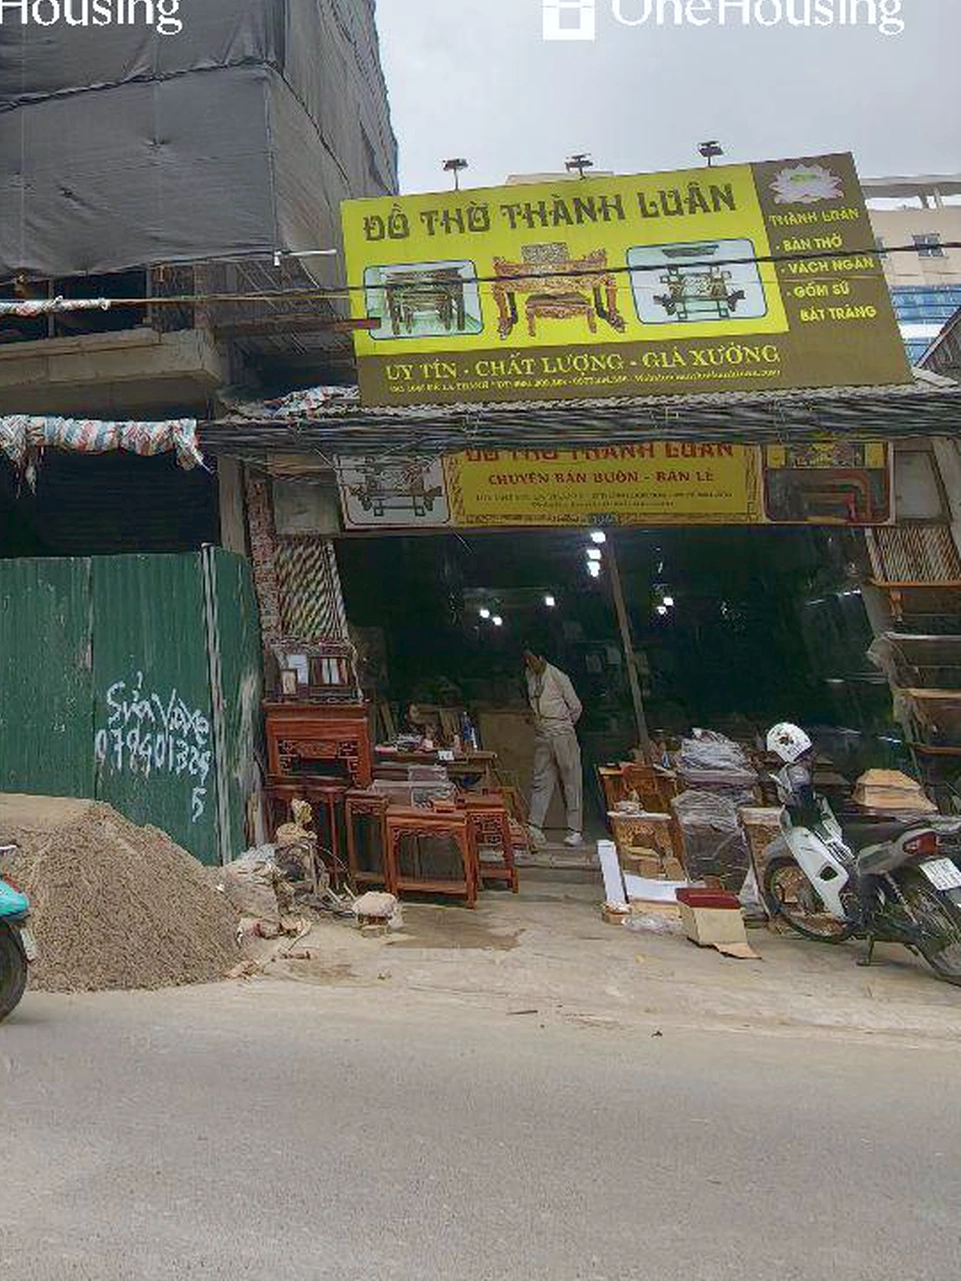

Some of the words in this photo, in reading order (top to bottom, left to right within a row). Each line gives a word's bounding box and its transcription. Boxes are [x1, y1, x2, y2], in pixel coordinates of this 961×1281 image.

[363, 203, 410, 241] ĐỒ
[420, 201, 491, 236] THỜ
[500, 194, 626, 229] THÀNH
[636, 182, 737, 218] LUÂN
[386, 364, 413, 380] UY
[418, 358, 458, 379] TÍN
[474, 352, 535, 377] CHẤT
[540, 353, 624, 379] LƯỢNG
[641, 349, 686, 369] GIÁ
[688, 341, 781, 365] XƯỞNG
